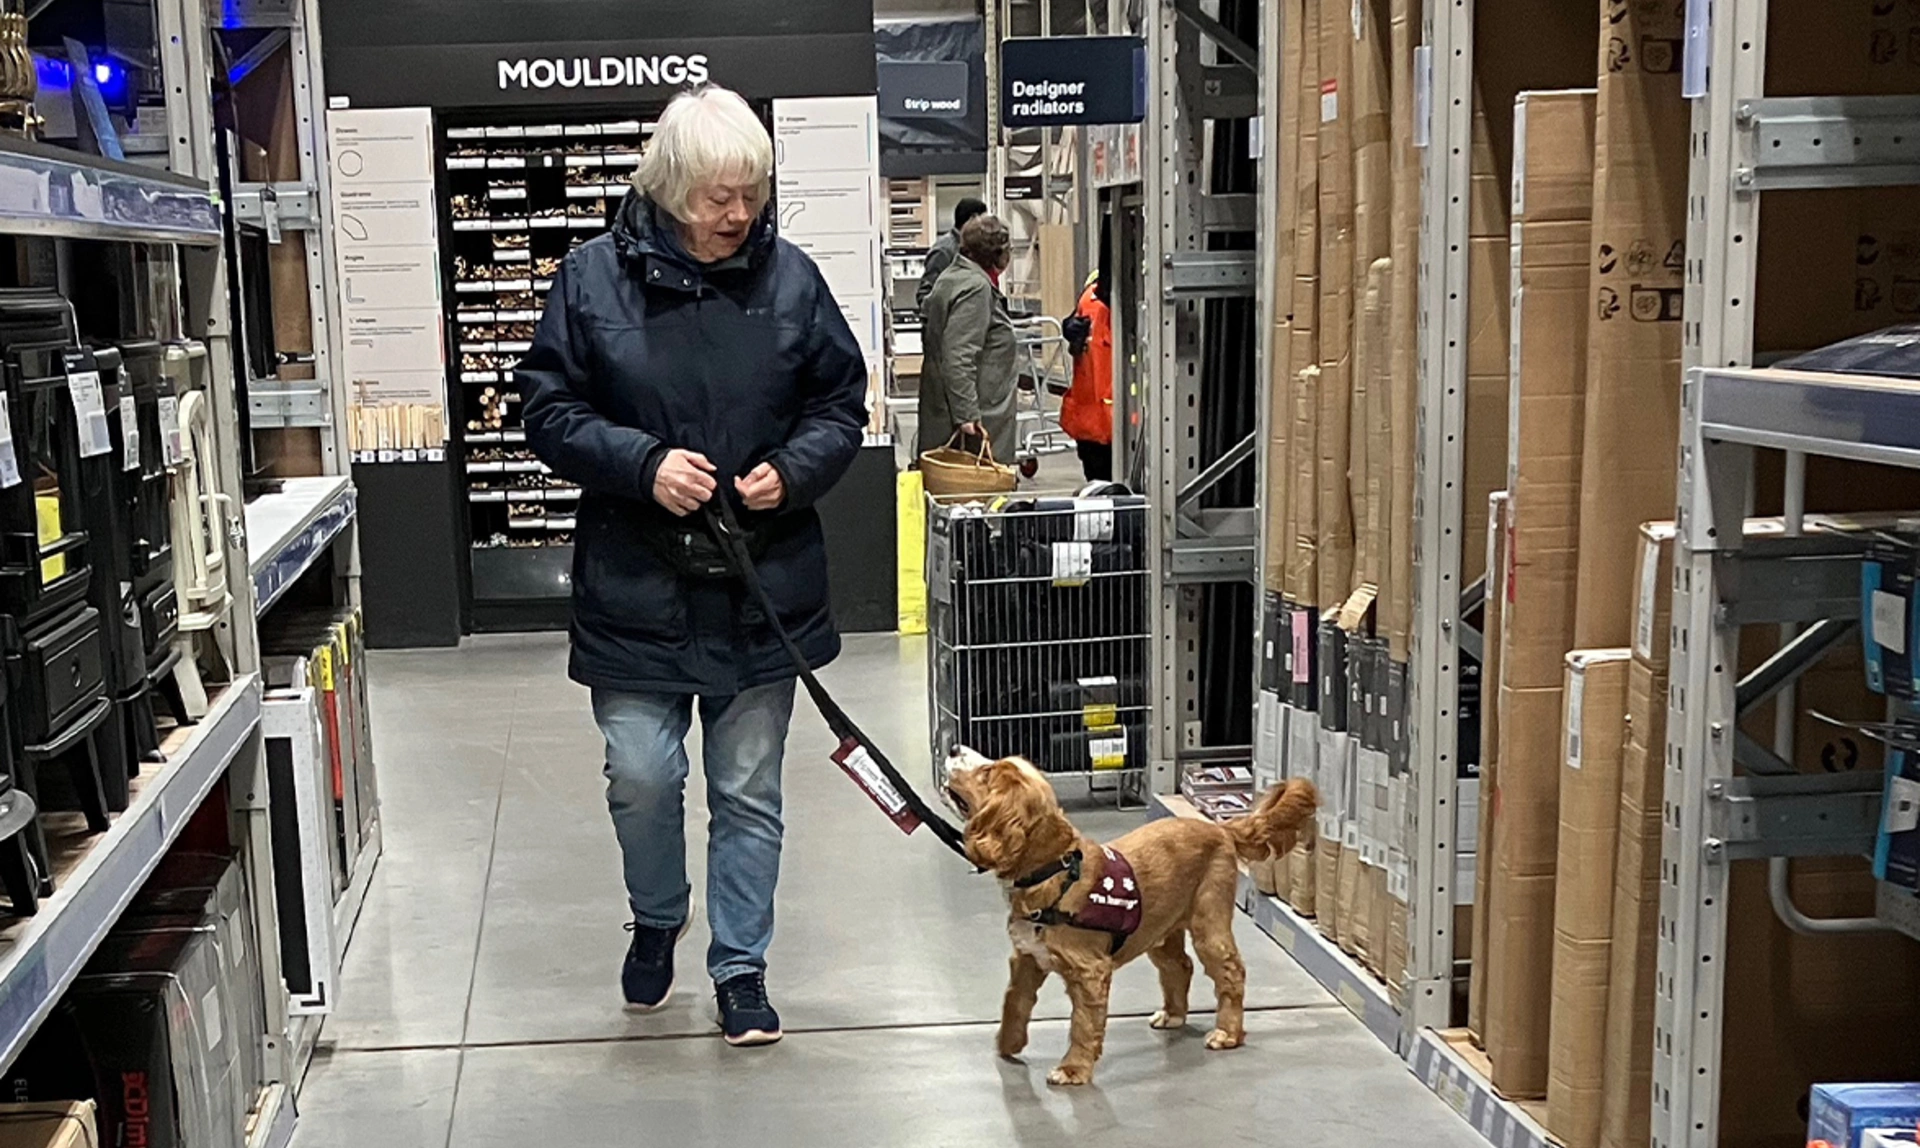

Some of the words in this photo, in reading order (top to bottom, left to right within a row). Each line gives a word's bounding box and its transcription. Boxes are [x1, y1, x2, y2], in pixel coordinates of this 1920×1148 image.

[498, 54, 708, 89] MOULDINGS
[1012, 80, 1085, 99] Designer
[904, 98, 930, 111] Strip
[931, 99, 960, 109] wood
[1012, 99, 1085, 116] radiators
